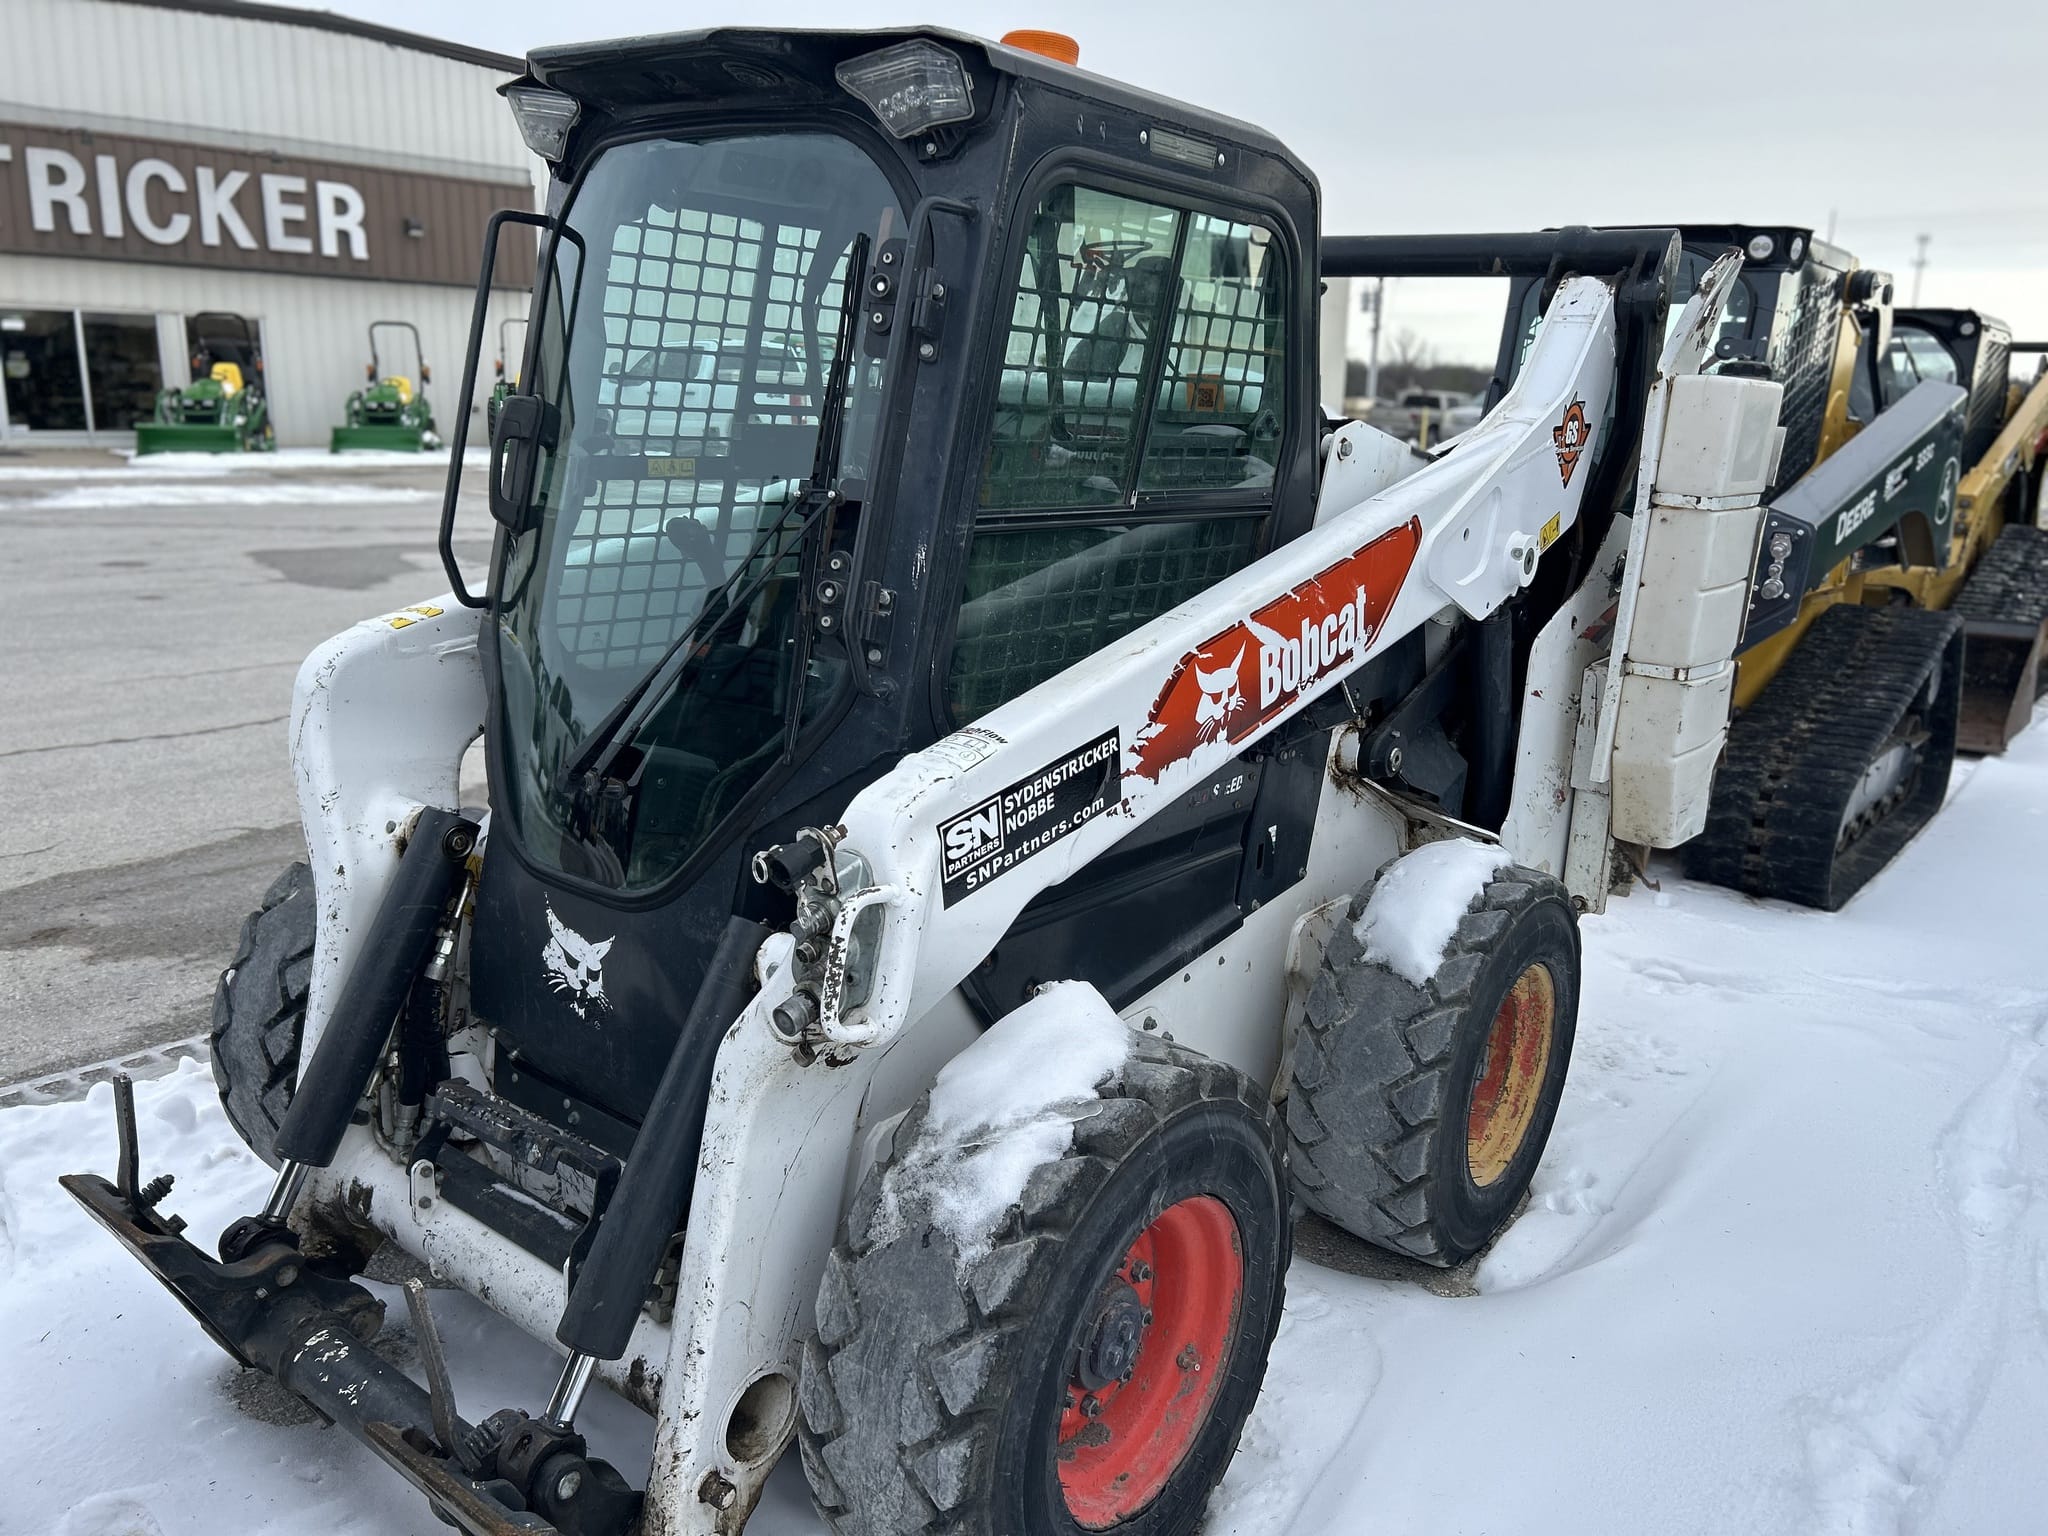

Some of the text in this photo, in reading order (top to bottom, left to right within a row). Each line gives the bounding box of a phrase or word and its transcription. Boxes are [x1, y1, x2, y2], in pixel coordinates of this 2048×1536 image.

[0, 144, 370, 260] RICKER
[1566, 420, 1579, 444] GS
[1835, 488, 1878, 546] DEERE
[1259, 584, 1367, 711] Bobcat
[1004, 736, 1119, 814] SYDENSTRICKER
[966, 796, 1105, 890] SNPartners.com
[1005, 791, 1056, 835] NOBBE
[948, 837, 1000, 874] PARTNERS
